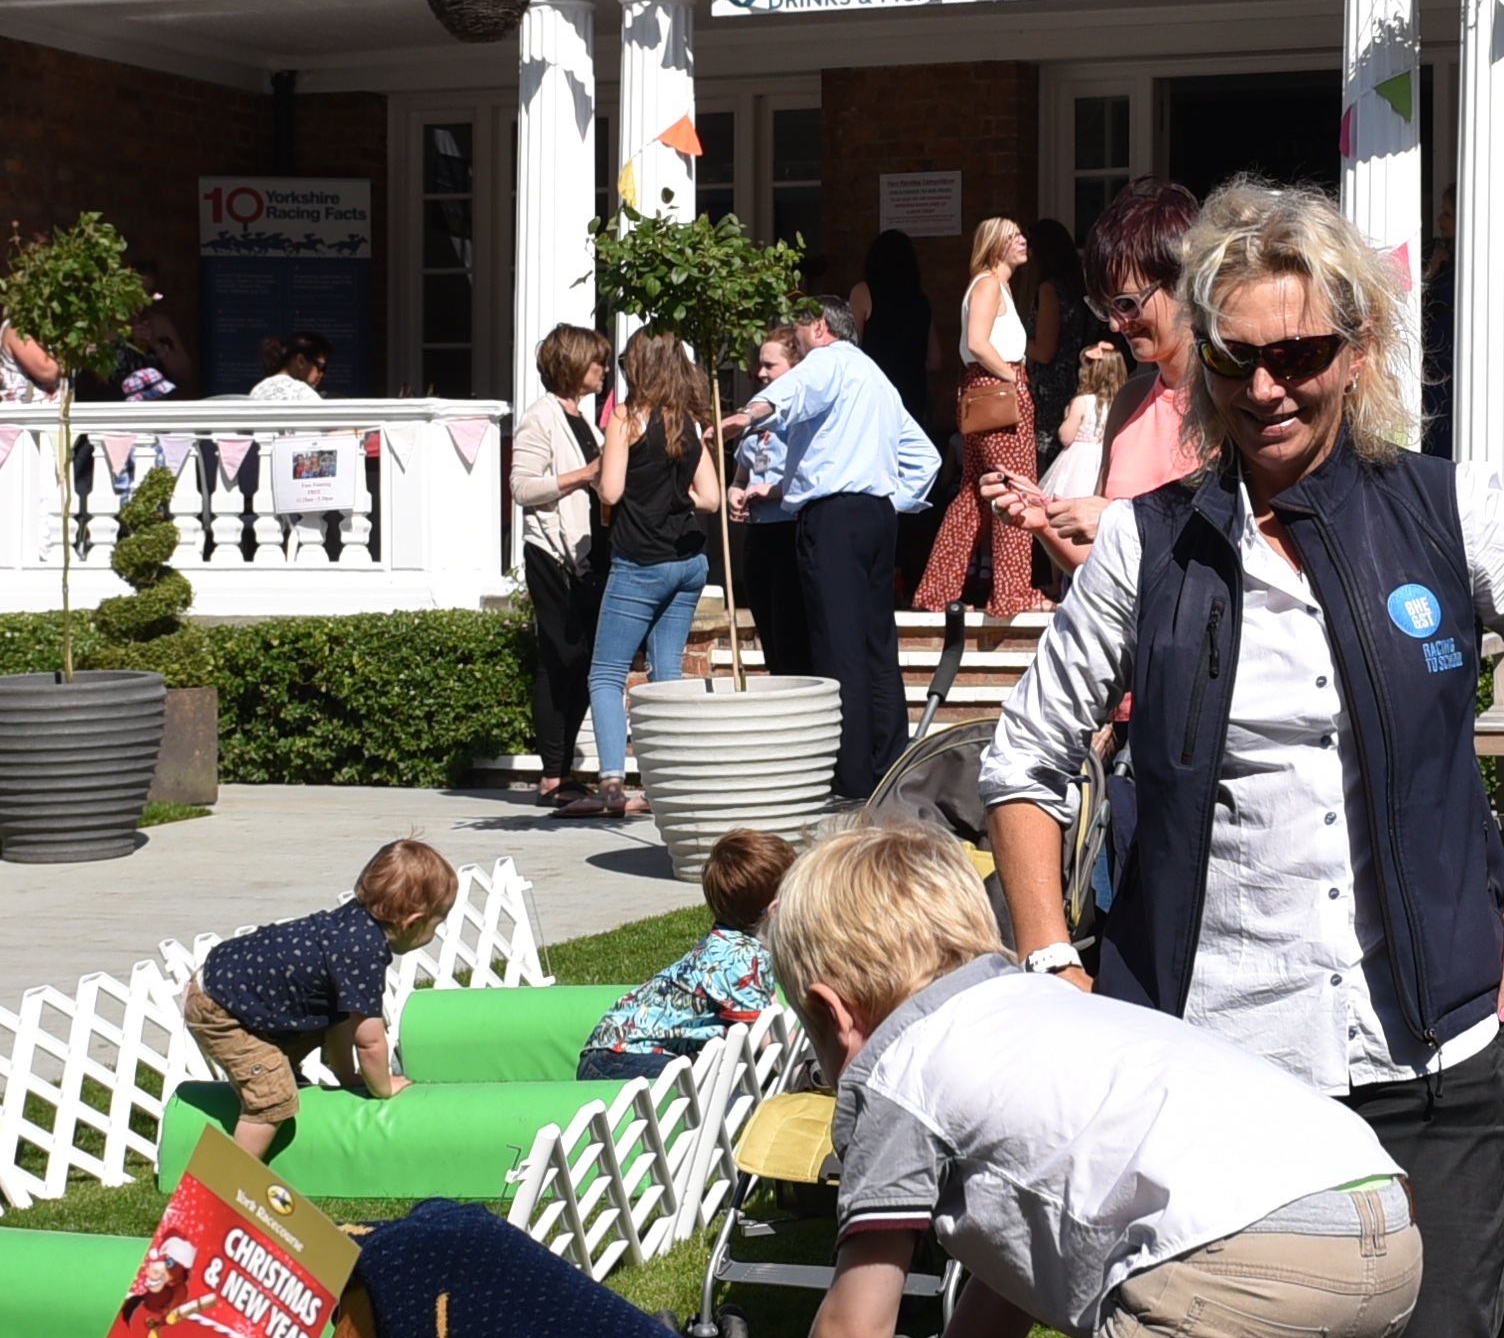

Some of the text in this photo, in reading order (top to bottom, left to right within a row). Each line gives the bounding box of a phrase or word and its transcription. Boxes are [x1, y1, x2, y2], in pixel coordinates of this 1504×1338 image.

[204, 187, 265, 225] 10
[265, 190, 340, 205] Yorkshire
[266, 206, 367, 223] Racing Facts
[1422, 638, 1456, 657] RACING
[1425, 651, 1464, 673] TO SCHOOL
[224, 1228, 323, 1326] CHRISTMAS
[204, 1257, 224, 1290] &
[221, 1269, 272, 1325] NEW
